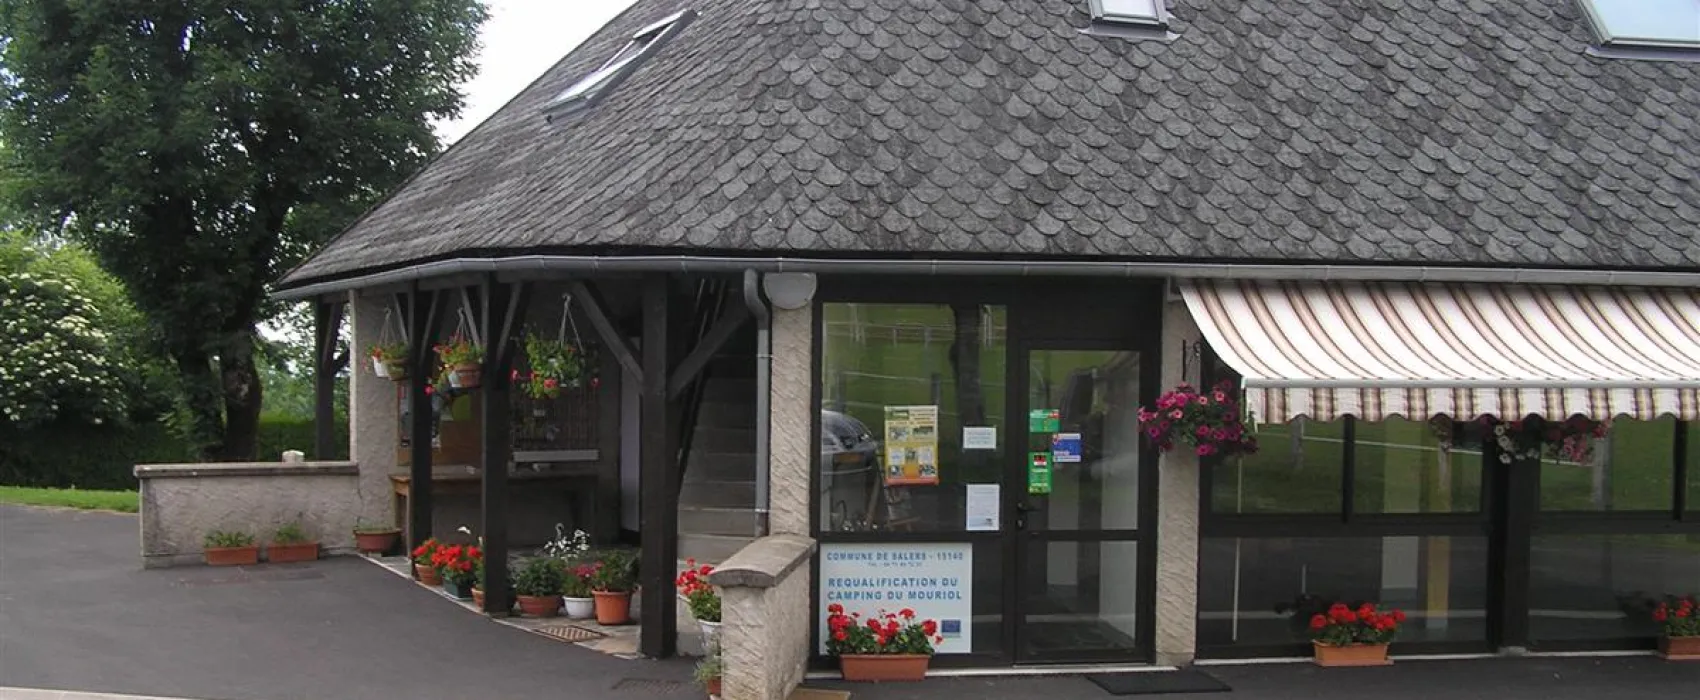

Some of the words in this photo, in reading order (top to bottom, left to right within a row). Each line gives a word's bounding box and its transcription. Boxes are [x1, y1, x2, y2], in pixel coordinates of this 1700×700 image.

[826, 551, 873, 561] COMMUNE
[877, 551, 889, 561] DE
[828, 577, 936, 588] REQUALIFICATION
[942, 577, 957, 588] DU
[826, 591, 881, 600] CAMPING
[887, 591, 903, 600] DU
[908, 591, 962, 600] MOURIOL
